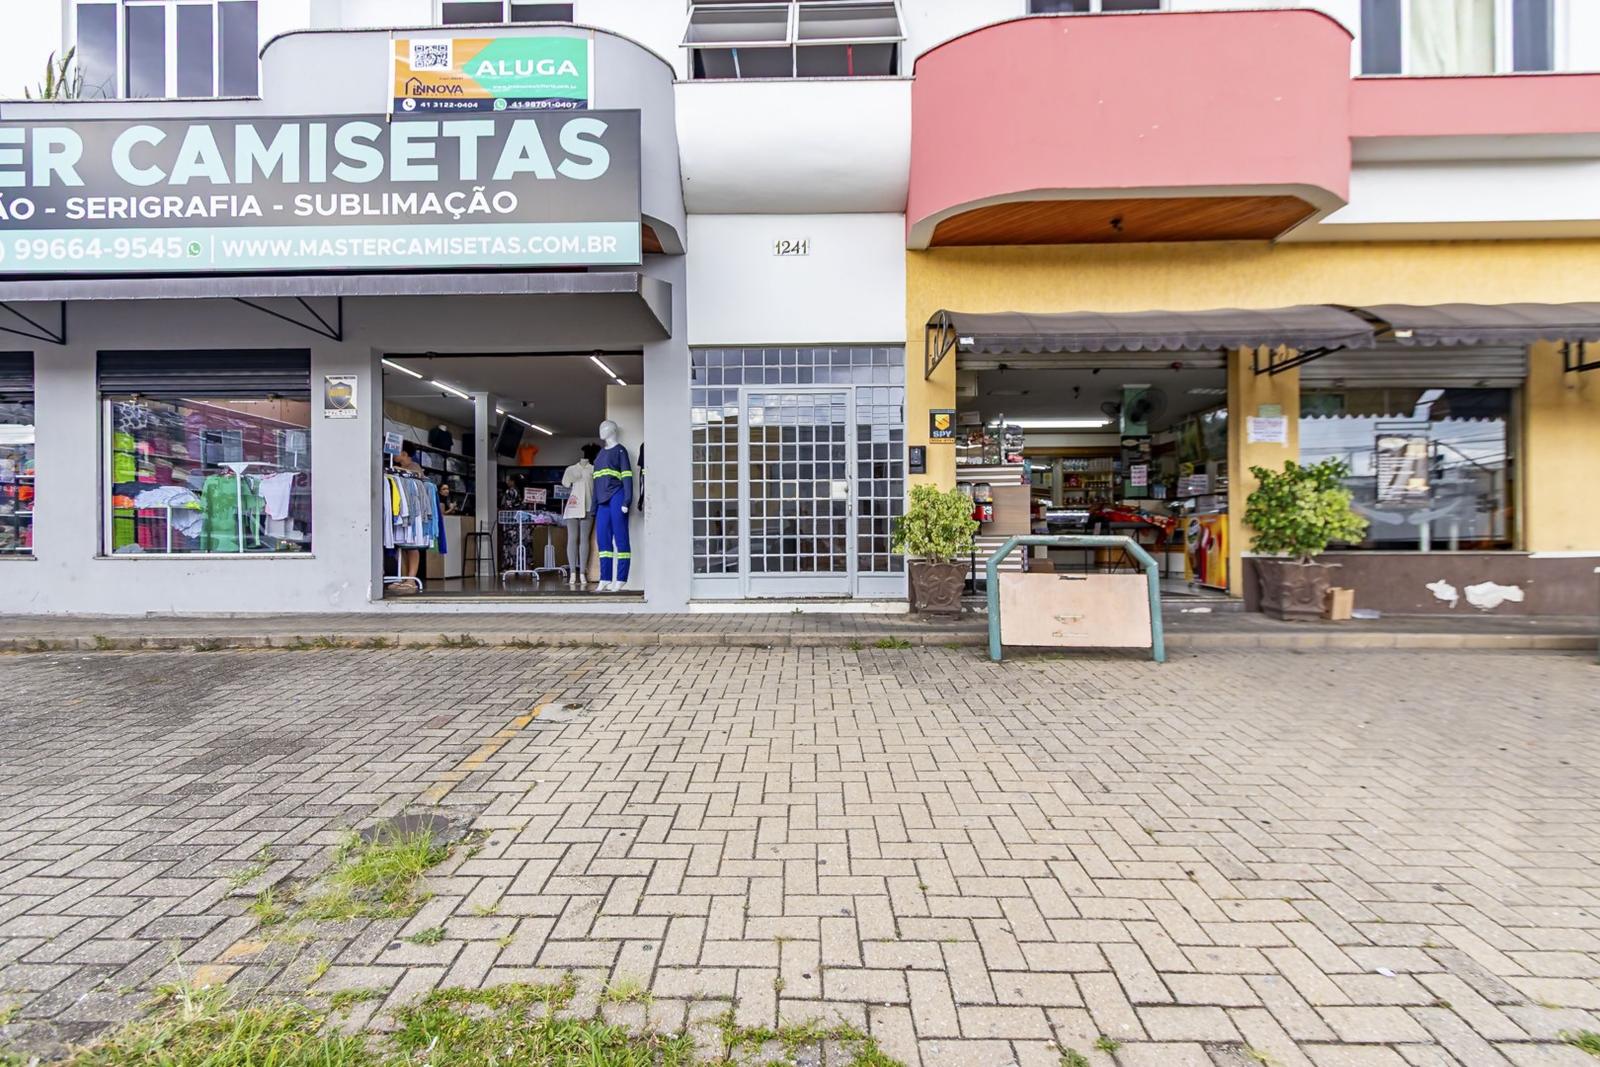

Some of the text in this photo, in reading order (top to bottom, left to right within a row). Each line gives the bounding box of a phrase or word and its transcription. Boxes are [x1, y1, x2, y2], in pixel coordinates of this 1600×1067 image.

[476, 59, 579, 77] ALUGA
[433, 101, 479, 109] 3122-0404
[524, 101, 578, 109] 98701-0407
[111, 117, 611, 187] CAMISETAS
[65, 195, 264, 219] SERIGRAFIA
[294, 185, 518, 220] SUBLIMAÇÃO
[14, 236, 184, 260] 99664-9545
[222, 235, 617, 259] WWW.MASTERCAMISETAS.COM.BR
[775, 239, 807, 255] 1241
[933, 430, 952, 438] SPY
